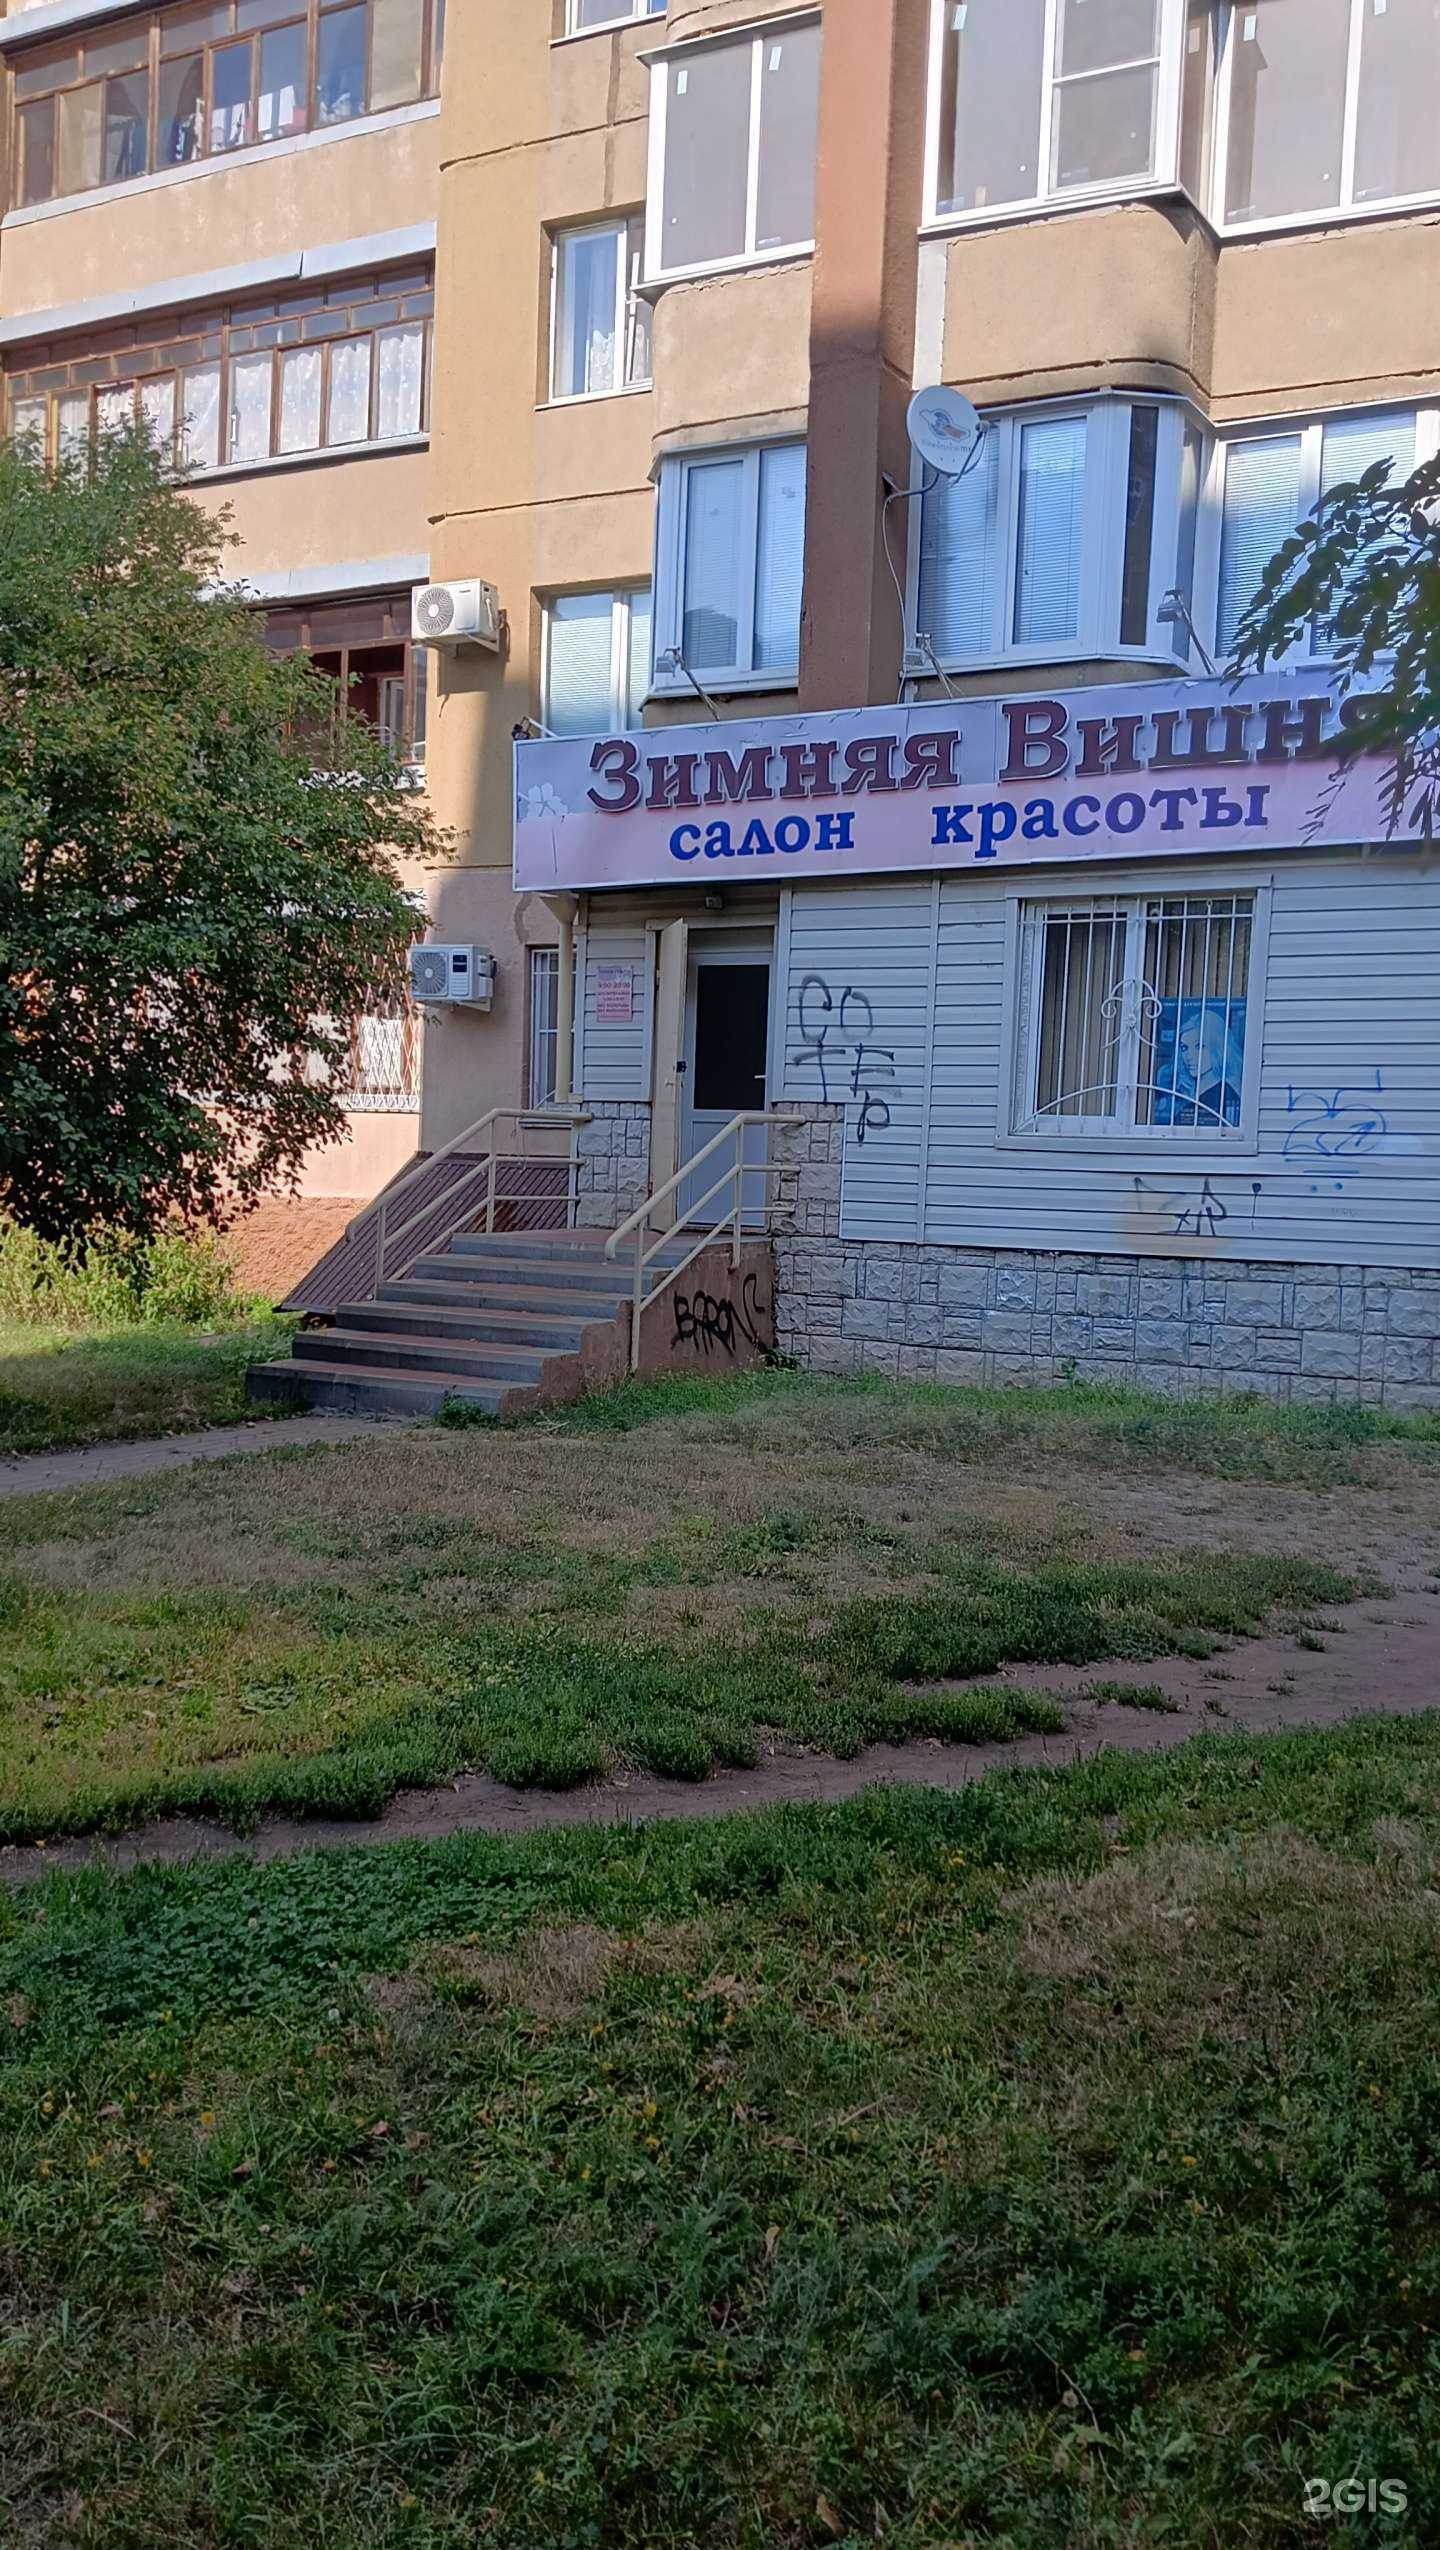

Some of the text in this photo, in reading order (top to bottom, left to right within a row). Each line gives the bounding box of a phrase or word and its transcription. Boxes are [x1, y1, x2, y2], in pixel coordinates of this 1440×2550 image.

[586, 729, 961, 813] Зимняя
[669, 785, 1270, 860] салон красоты
